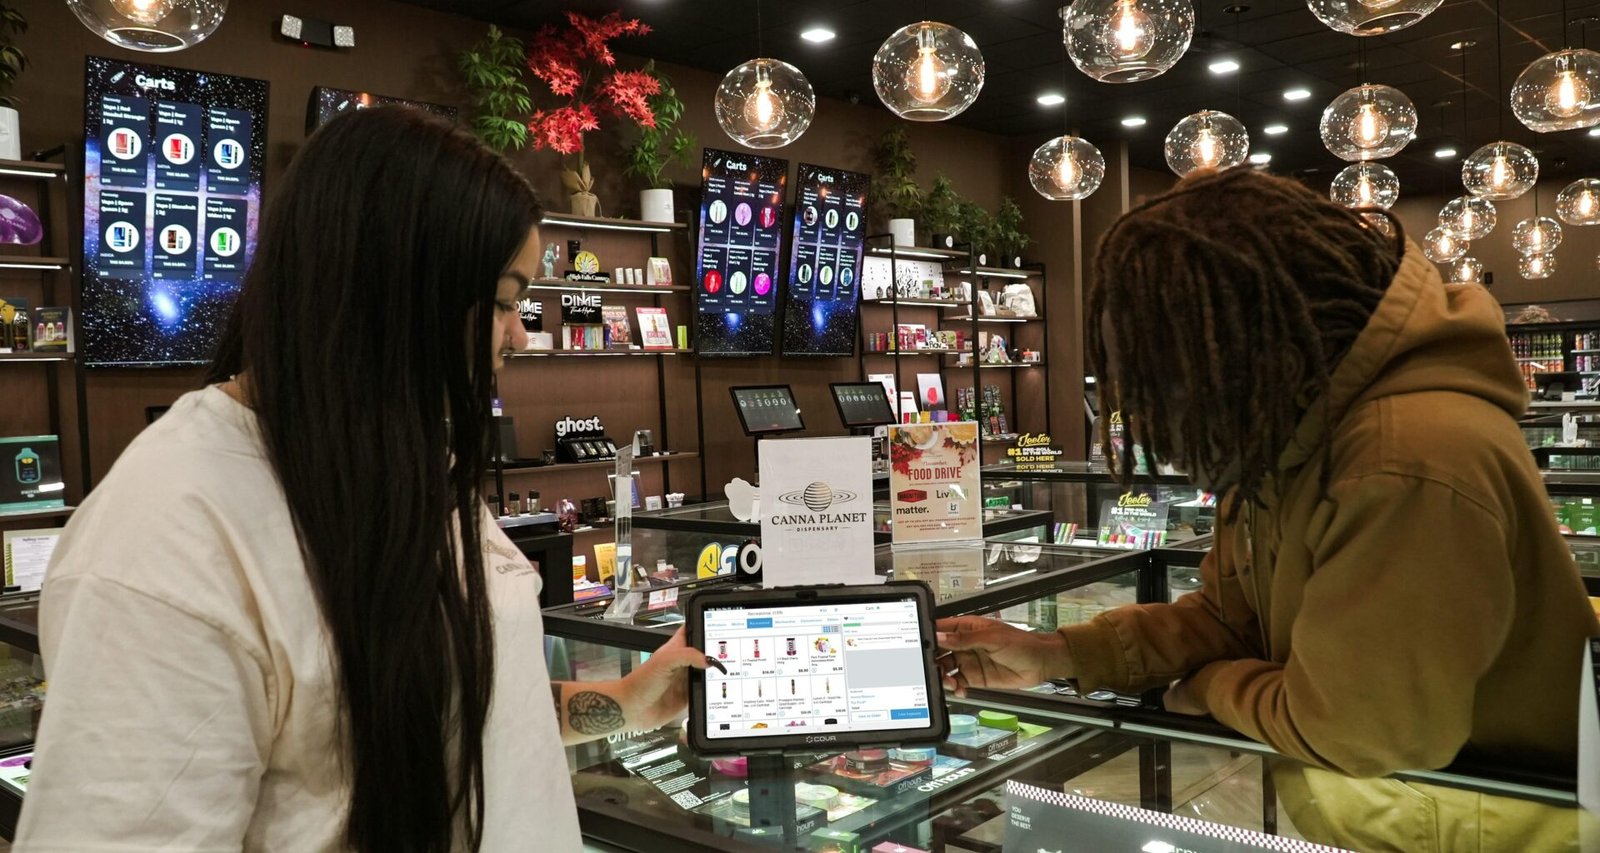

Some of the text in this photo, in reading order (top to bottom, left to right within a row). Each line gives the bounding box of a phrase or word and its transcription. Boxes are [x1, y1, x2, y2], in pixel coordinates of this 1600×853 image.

[135, 74, 176, 90] Carts
[726, 160, 747, 171] Carts
[818, 173, 834, 183] Carts
[562, 292, 601, 307] DIME
[556, 416, 604, 436] ghost.
[1018, 432, 1051, 447] Jeeter
[908, 466, 962, 480] FOOD DRIVE
[1118, 492, 1152, 507] Jeeter
[896, 506, 930, 515] matter.
[771, 512, 867, 525] CANNA PLANET
[995, 739, 1009, 748] hours
[906, 776, 922, 788] hours
[918, 768, 976, 792] Off hours
[1011, 812, 1030, 823] DESERVE
[797, 820, 815, 833] hours
[1011, 819, 1032, 831] THE BEST.
